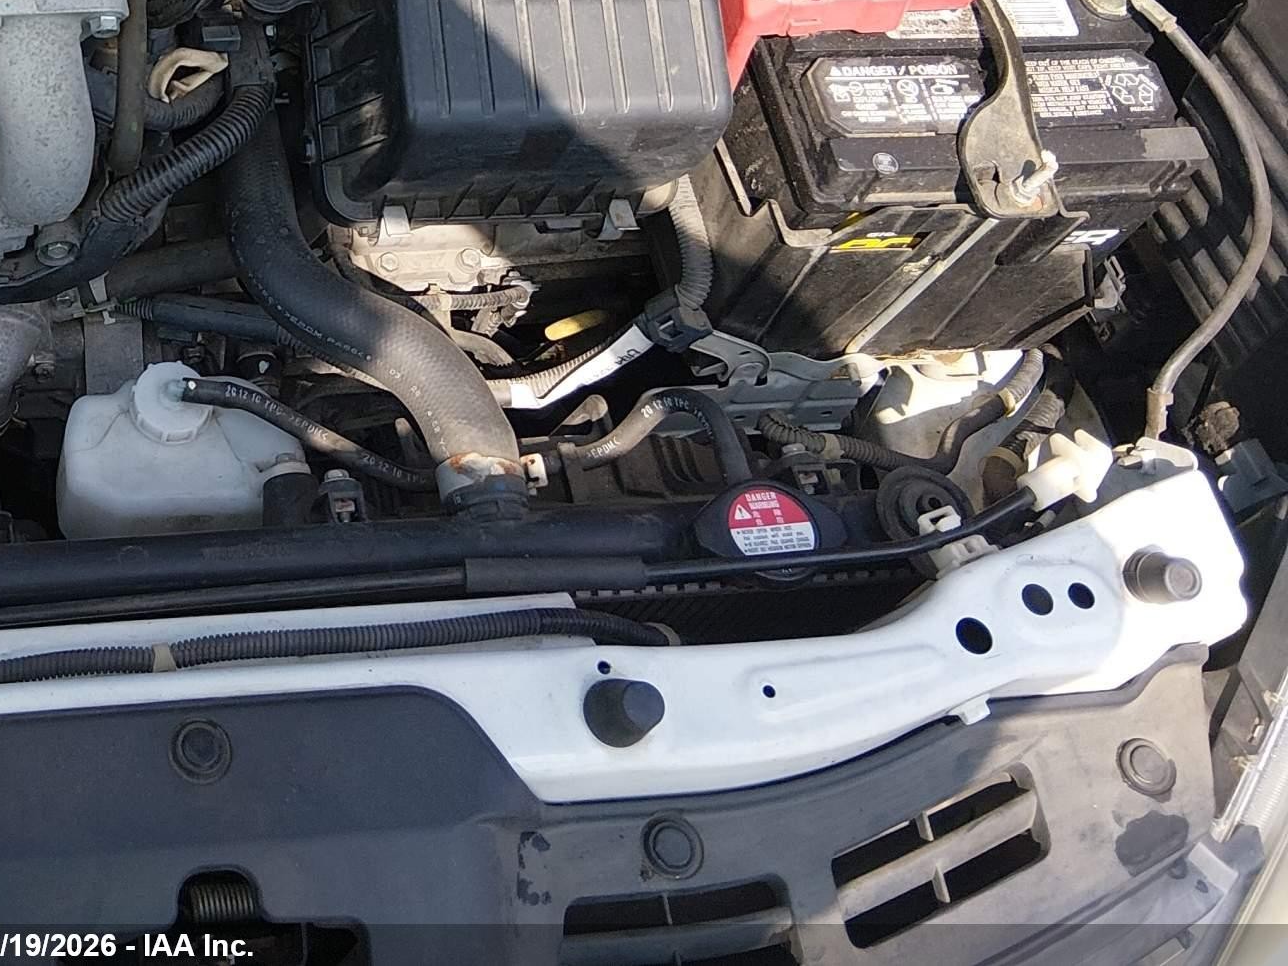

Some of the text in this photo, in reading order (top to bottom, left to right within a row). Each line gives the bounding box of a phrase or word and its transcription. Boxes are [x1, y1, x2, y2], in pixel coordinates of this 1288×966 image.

[842, 65, 897, 76] DANGER
[908, 63, 958, 76] POISON
[744, 491, 778, 502] DANGER
